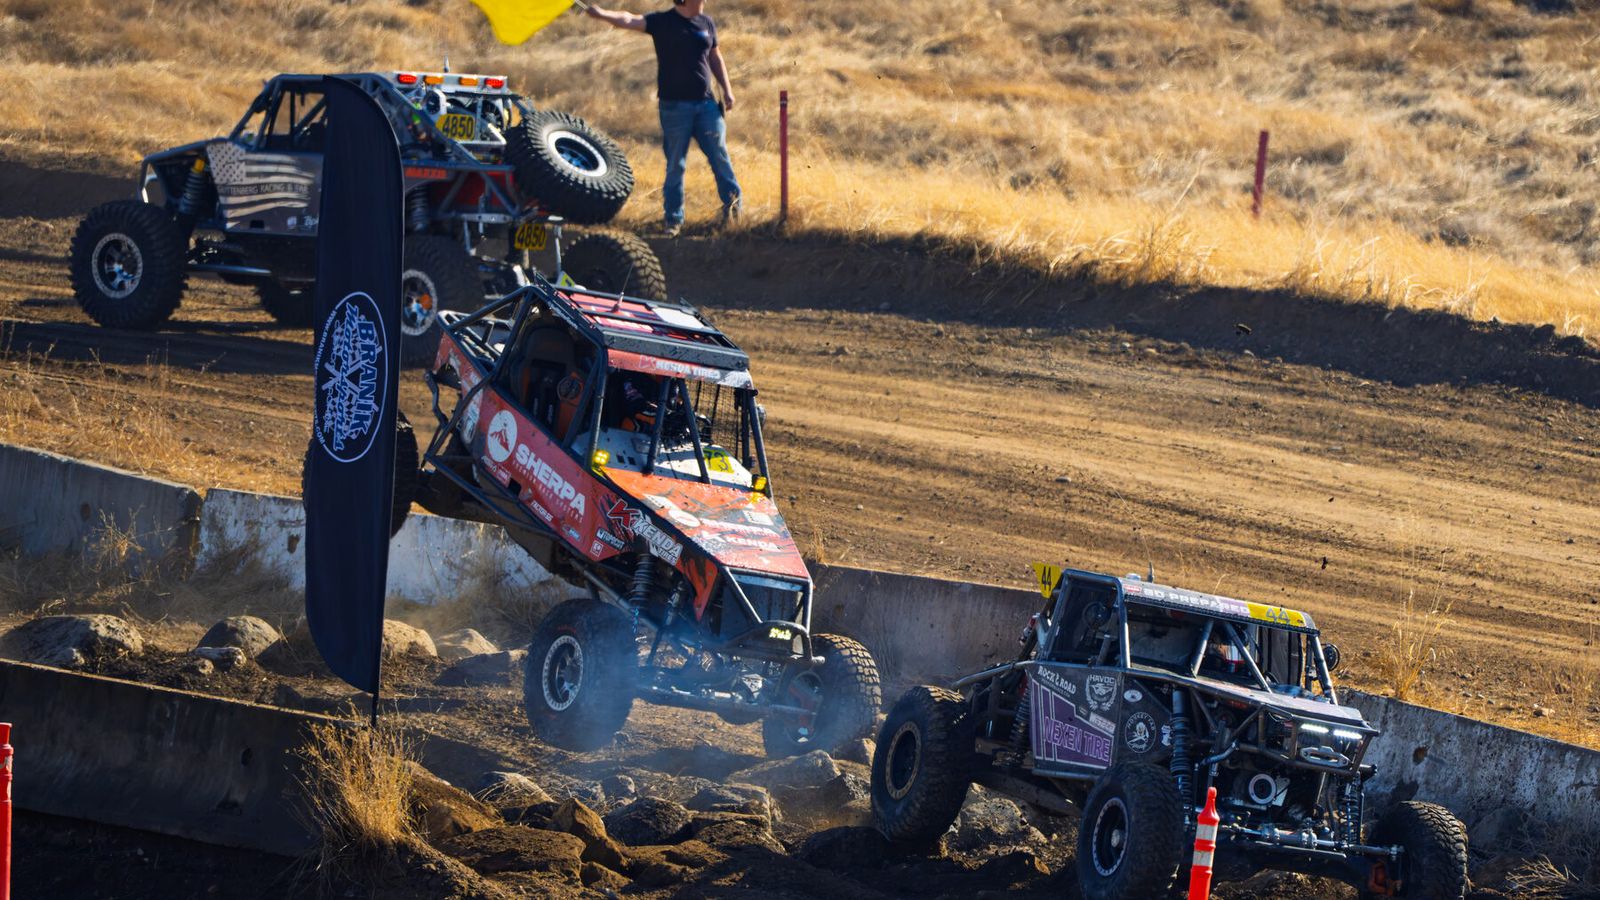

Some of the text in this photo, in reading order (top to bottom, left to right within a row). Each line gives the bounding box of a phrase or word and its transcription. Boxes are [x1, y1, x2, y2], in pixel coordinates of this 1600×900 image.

[442, 114, 474, 138] 4850
[516, 224, 546, 247] 4850
[333, 301, 360, 451] Motorsports
[349, 320, 379, 436] BRANIK
[515, 443, 586, 517] SHERPA
[631, 514, 684, 560] KENDA
[1041, 566, 1052, 588] 44
[1169, 593, 1249, 615] PREPARED
[1265, 608, 1291, 625] 44
[1038, 666, 1056, 681] ROCK
[1060, 679, 1077, 694] ROAD
[1089, 674, 1115, 684] HAVOC
[1044, 716, 1083, 753] NEXEN
[1083, 731, 1111, 762] TIRE
